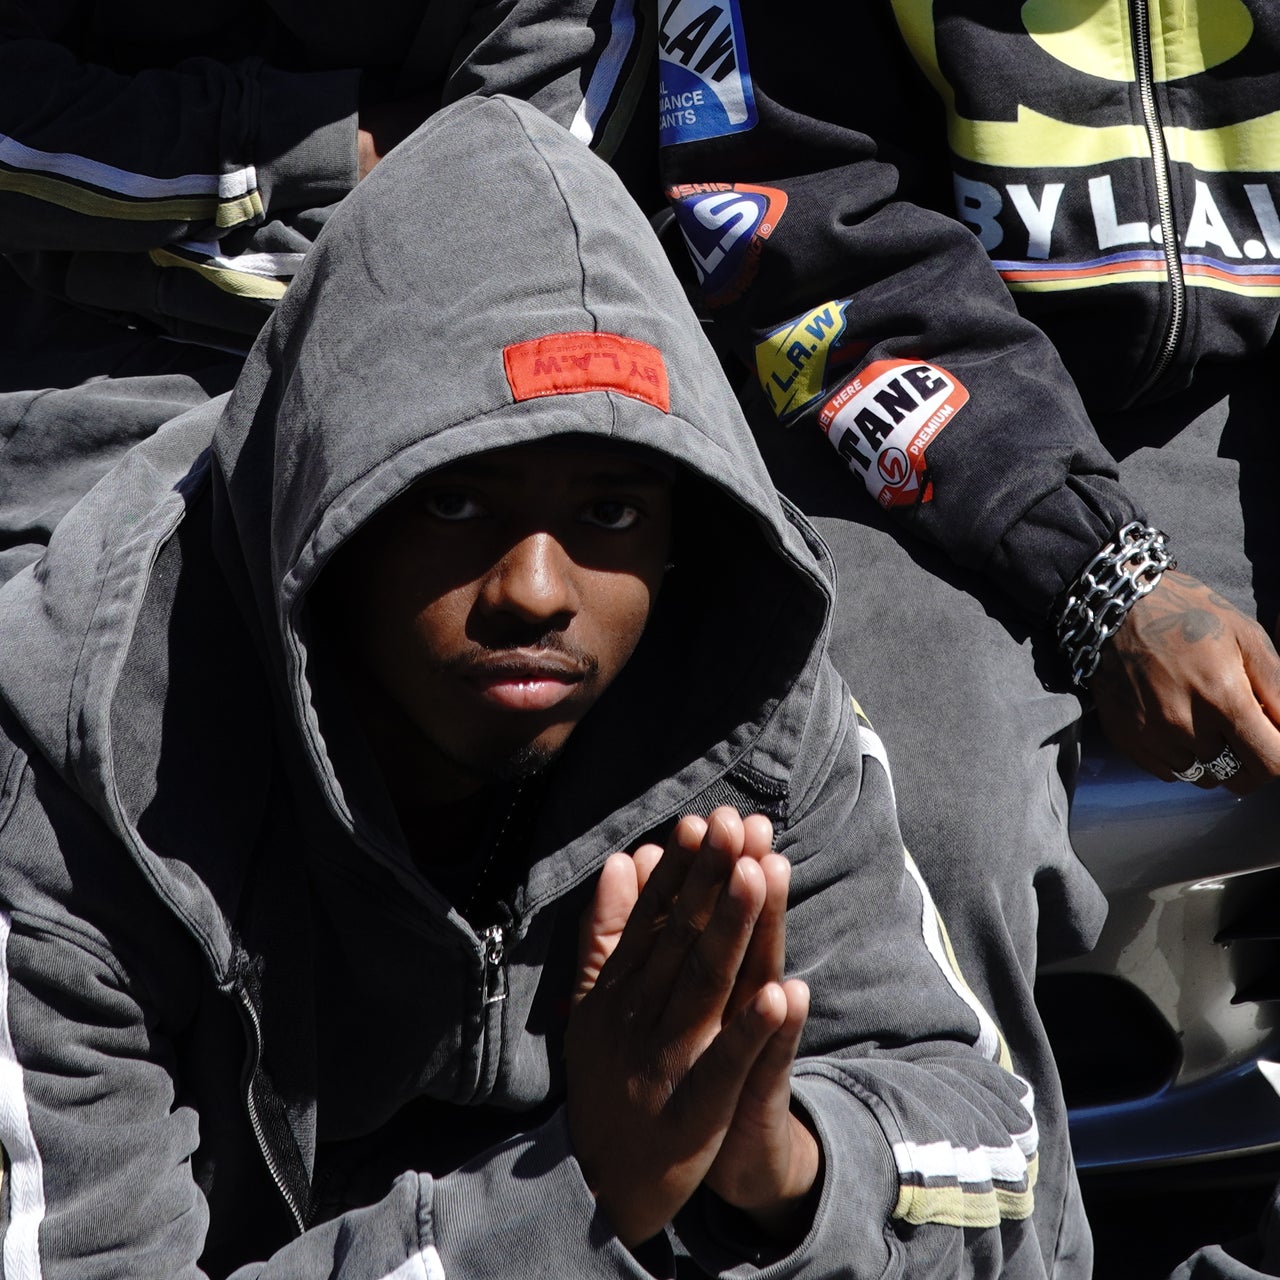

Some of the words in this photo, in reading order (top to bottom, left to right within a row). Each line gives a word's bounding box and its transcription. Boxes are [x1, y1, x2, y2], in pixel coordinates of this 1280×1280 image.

[953, 171, 1065, 260] BY
[832, 377, 864, 407] HERE
[836, 365, 949, 474] TANE
[909, 403, 955, 456] PREMIUM
